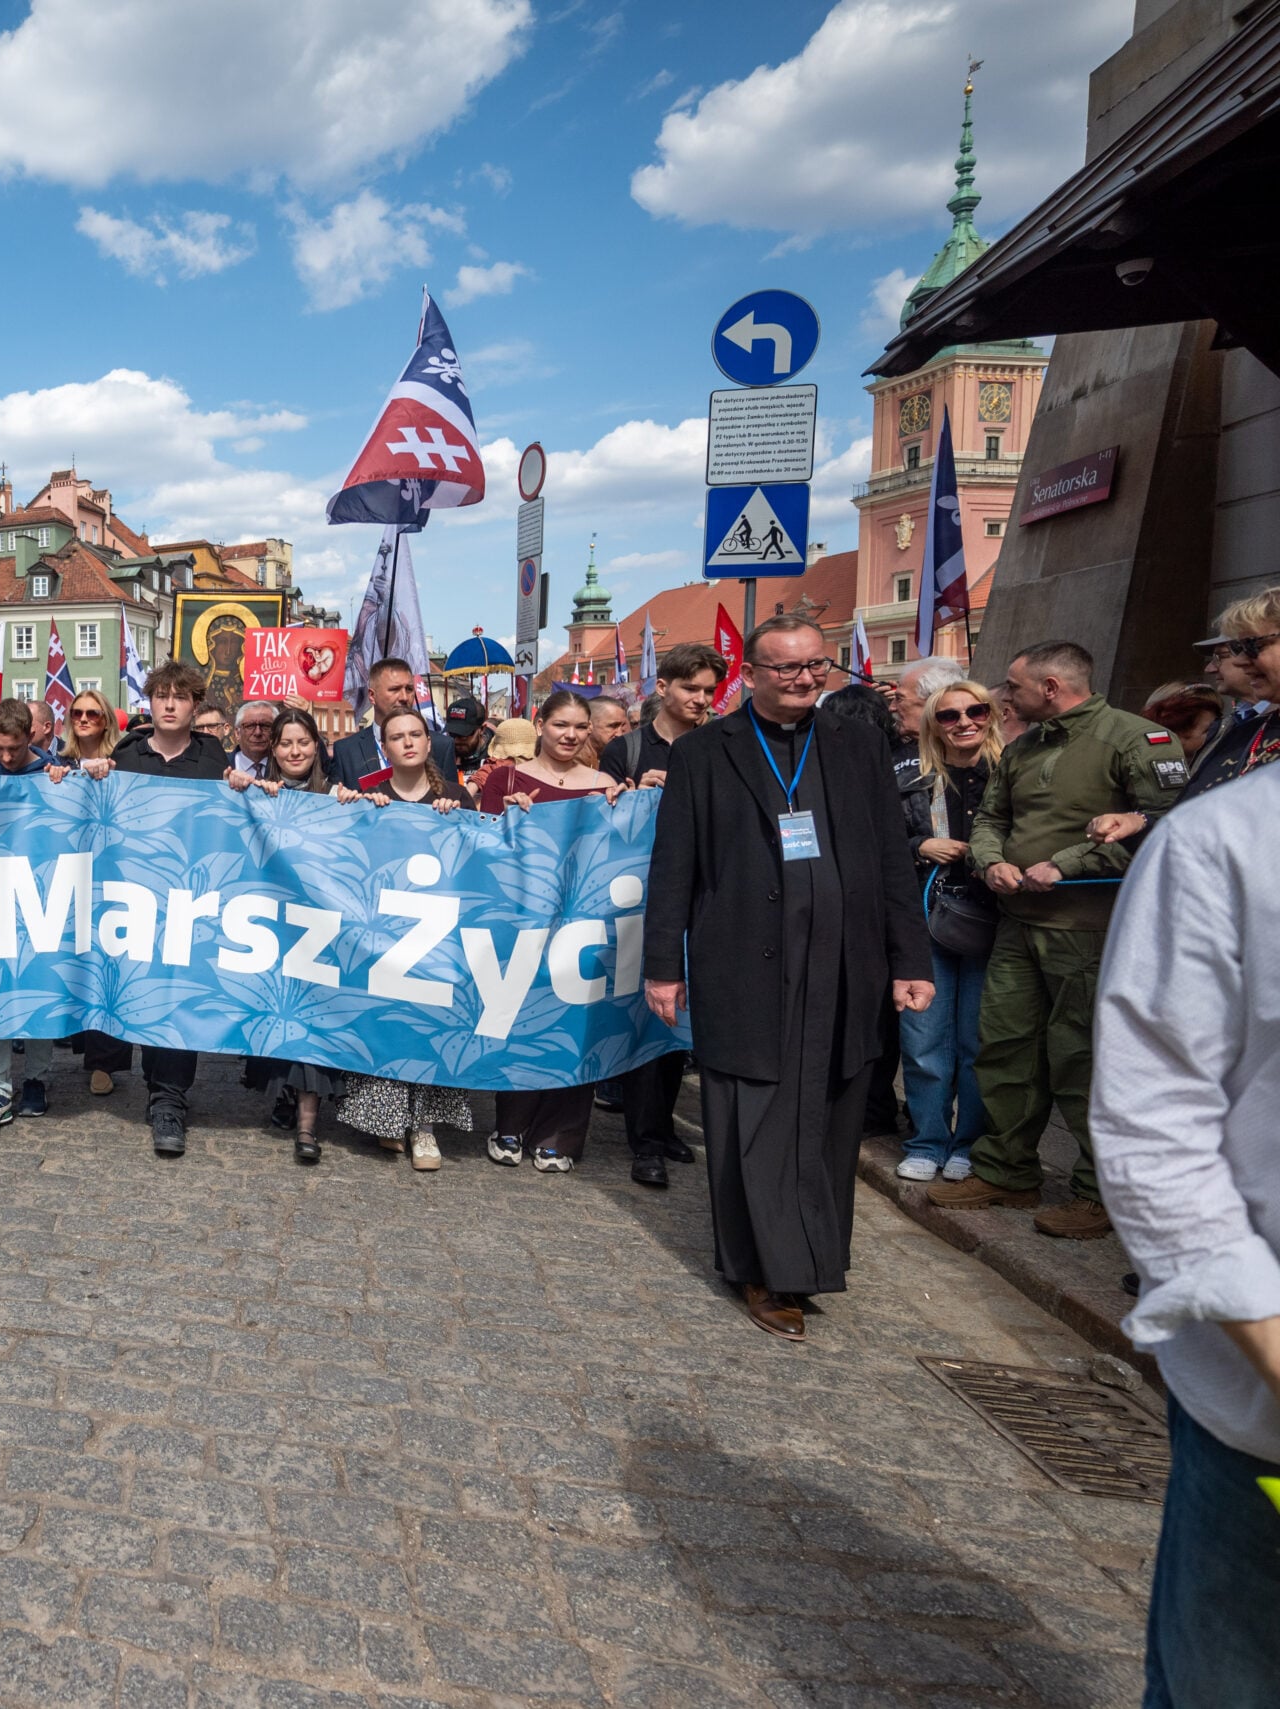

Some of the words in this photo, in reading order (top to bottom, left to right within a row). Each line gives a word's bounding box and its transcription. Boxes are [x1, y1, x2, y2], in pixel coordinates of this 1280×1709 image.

[1032, 466, 1097, 505] Senatorska
[252, 632, 291, 658] TAK
[261, 657, 286, 673] dla
[249, 670, 298, 696] ŻYCIA
[367, 853, 645, 1040] Życi
